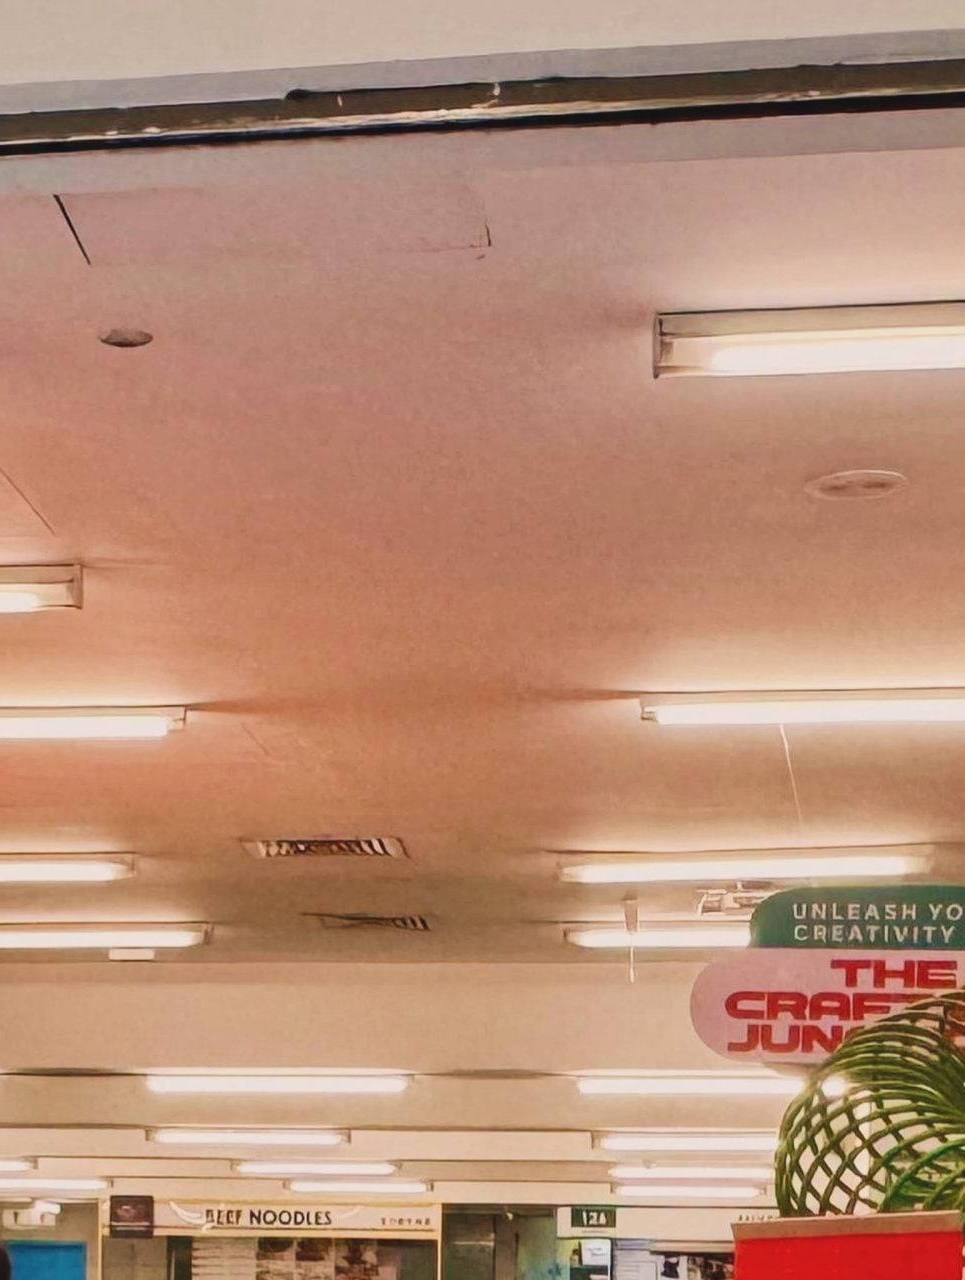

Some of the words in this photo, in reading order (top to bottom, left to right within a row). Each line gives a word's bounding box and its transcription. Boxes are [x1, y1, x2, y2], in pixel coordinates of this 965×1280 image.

[792, 903, 917, 921] UNLEASH
[793, 924, 955, 944] CREATIVITY
[830, 959, 958, 990] THE
[724, 990, 935, 1022] CRAF
[727, 1023, 864, 1054] JUN
[205, 1208, 243, 1226] BEEF
[248, 1208, 332, 1226] NOODLES
